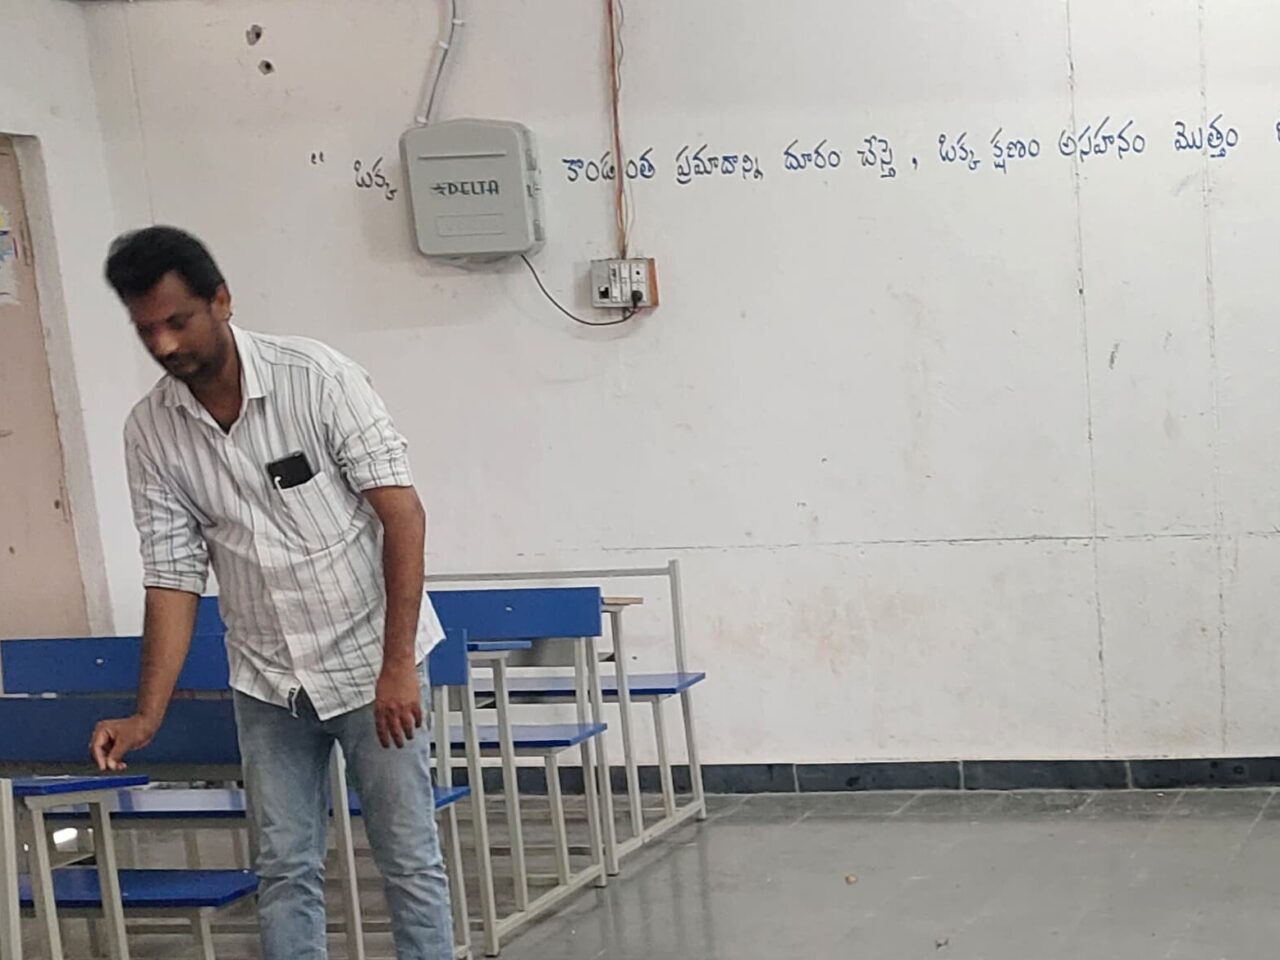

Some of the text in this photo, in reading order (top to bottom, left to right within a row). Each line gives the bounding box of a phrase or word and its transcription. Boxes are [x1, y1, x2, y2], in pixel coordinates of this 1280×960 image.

[784, 139, 841, 170] దూరం
[938, 131, 981, 170] ఒక్క
[990, 127, 1040, 174] క్షణం
[1058, 115, 1145, 162] అసహనం
[446, 179, 500, 196] DELTA
